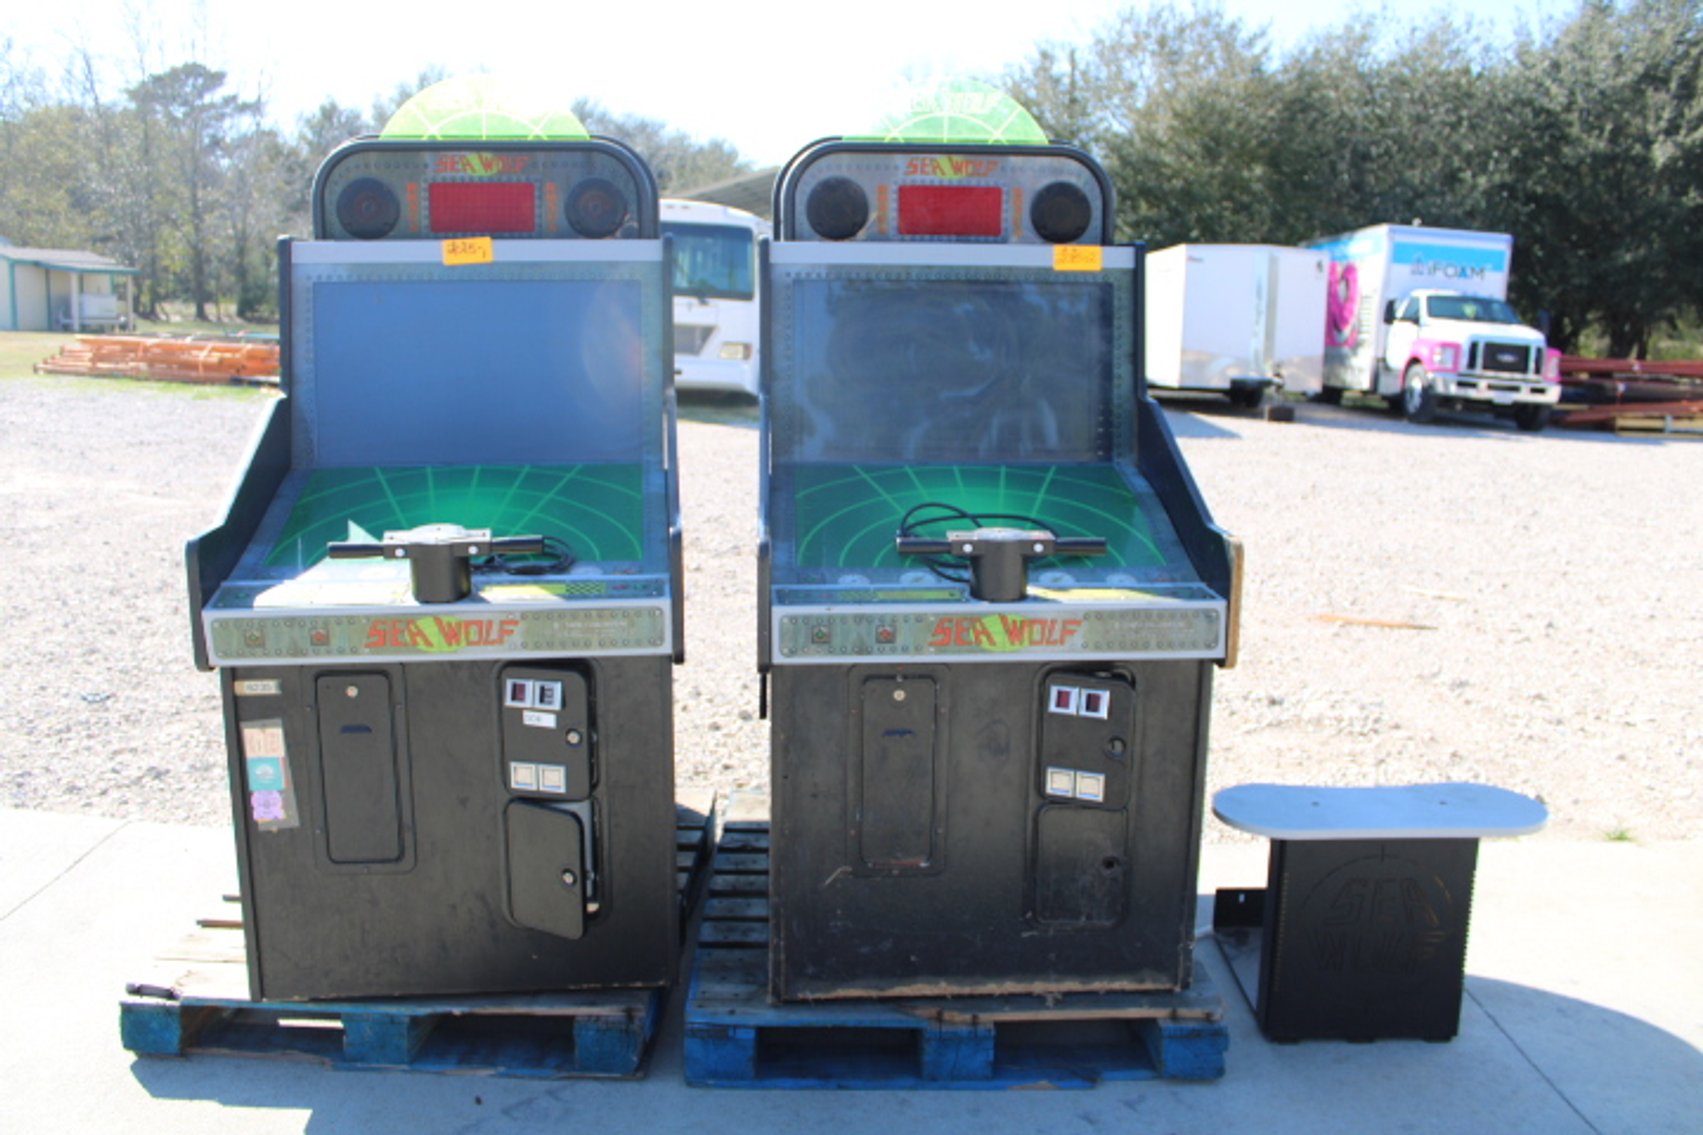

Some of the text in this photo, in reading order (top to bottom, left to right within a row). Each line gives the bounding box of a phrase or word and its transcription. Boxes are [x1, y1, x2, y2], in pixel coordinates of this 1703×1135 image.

[435, 152, 529, 174] SEA WOLF
[904, 156, 1000, 177] SEA WOLF
[363, 615, 522, 650] SEA WOLF
[927, 616, 995, 648] SEA
[997, 614, 1084, 648] WOLF
